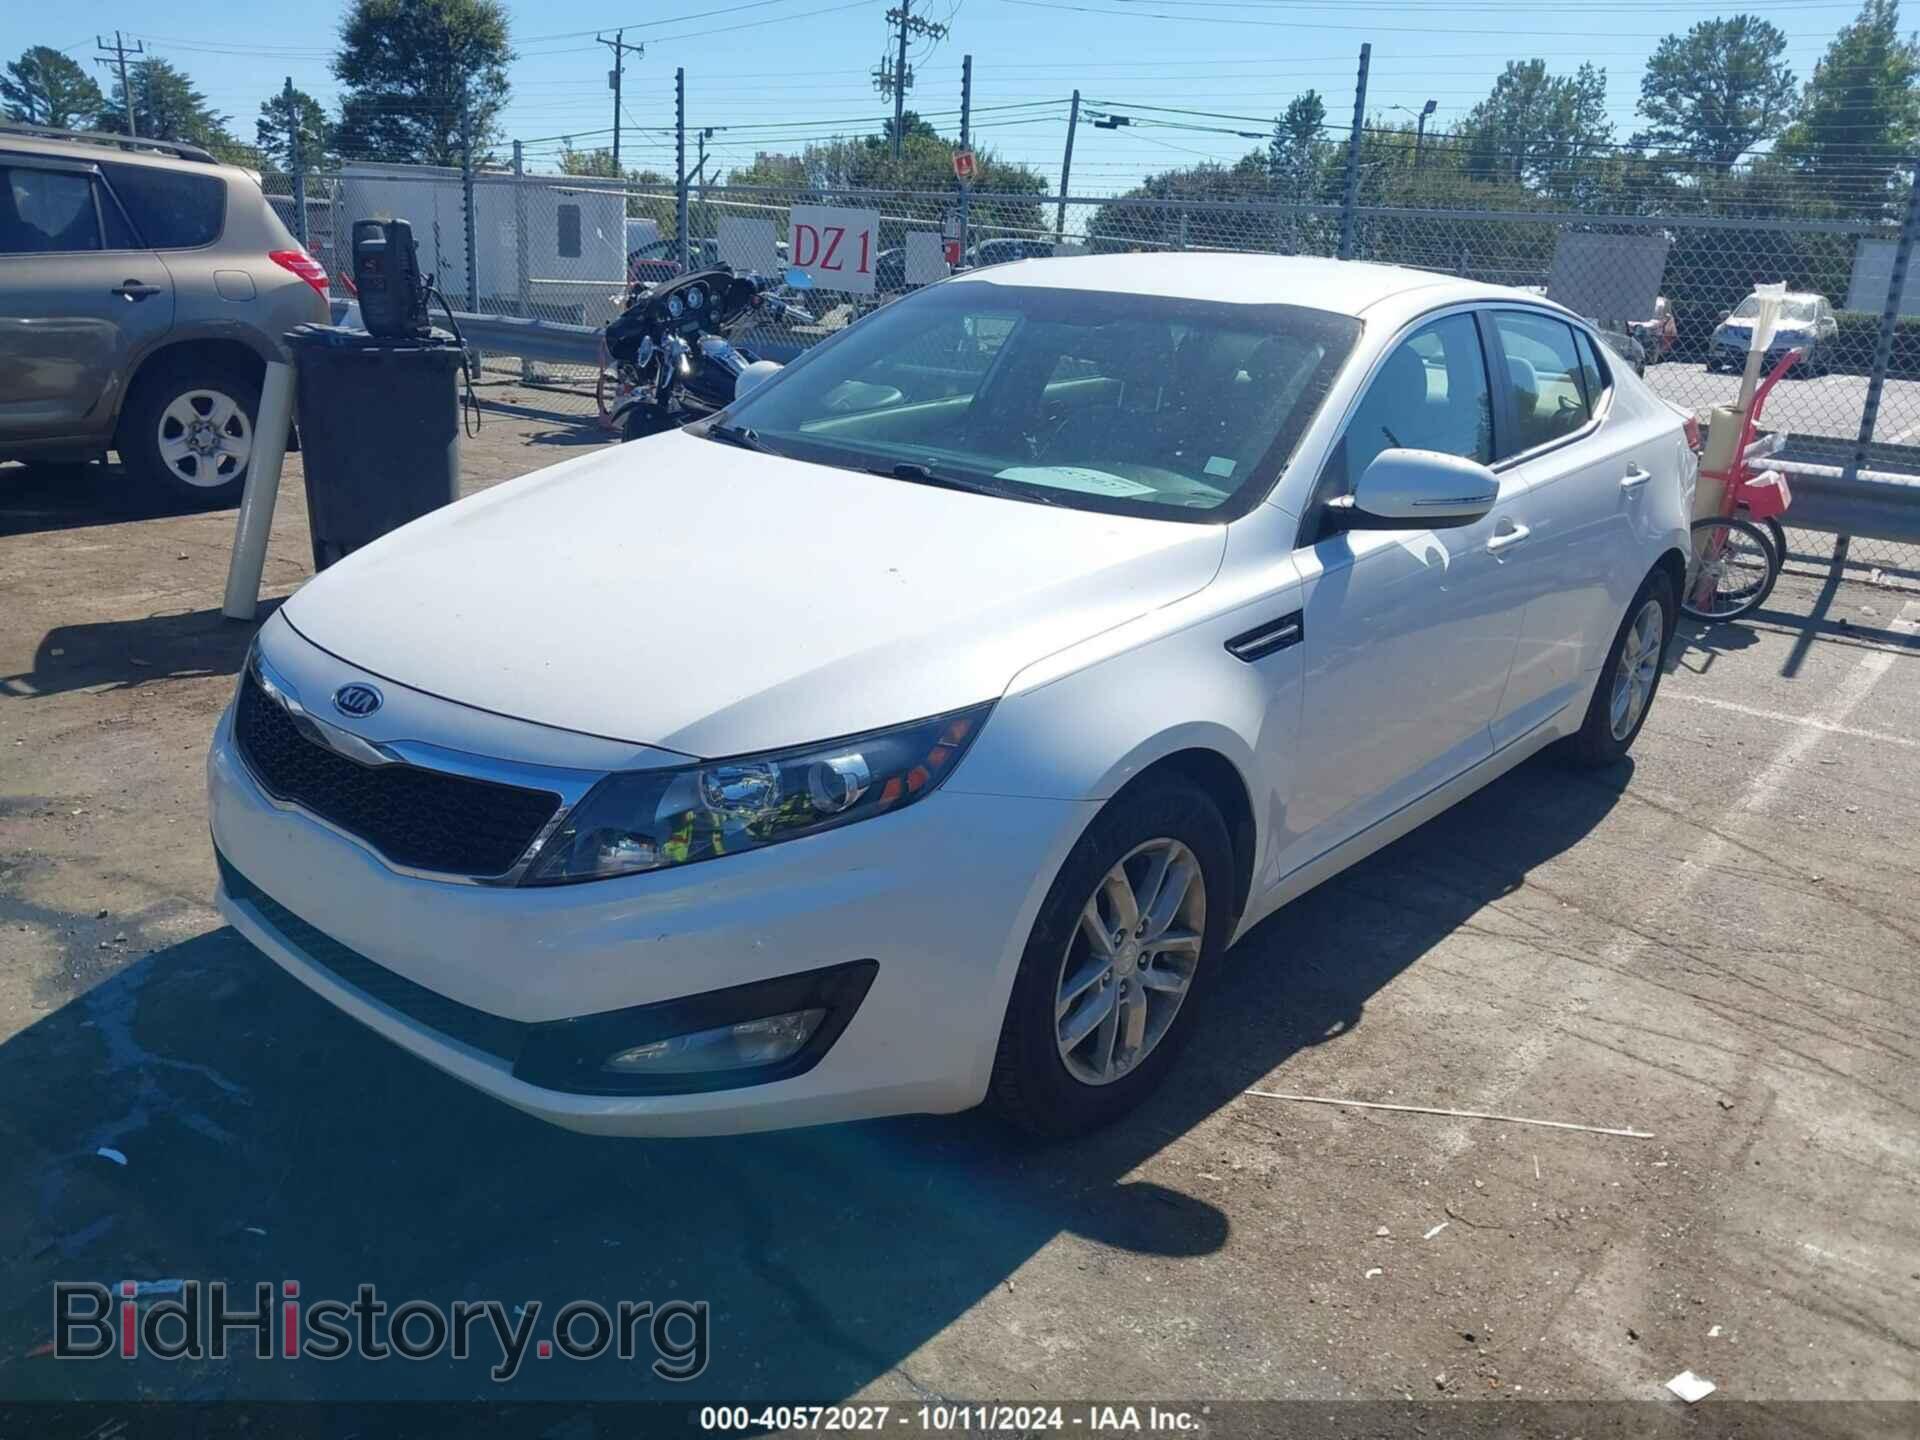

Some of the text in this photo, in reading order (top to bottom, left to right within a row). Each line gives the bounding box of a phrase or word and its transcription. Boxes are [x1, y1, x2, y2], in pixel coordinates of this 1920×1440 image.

[792, 224, 871, 274] DZ 1
[340, 687, 374, 712] KIA
